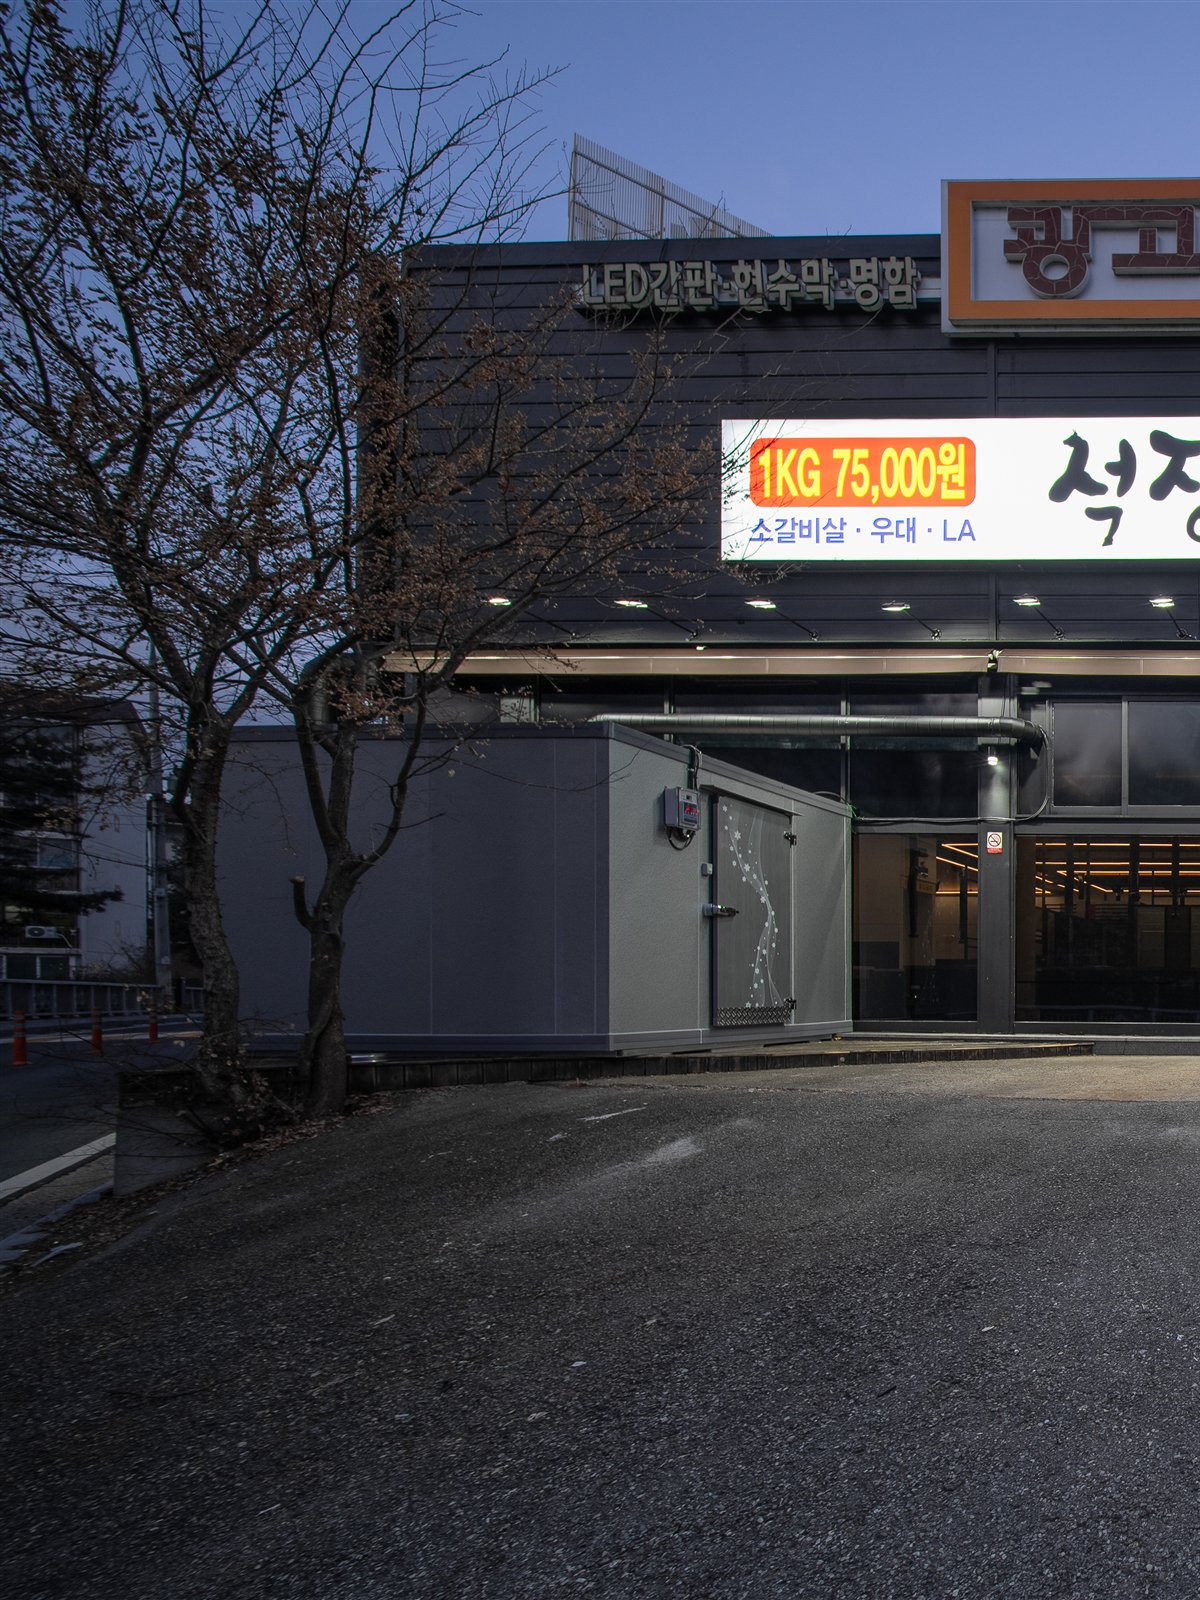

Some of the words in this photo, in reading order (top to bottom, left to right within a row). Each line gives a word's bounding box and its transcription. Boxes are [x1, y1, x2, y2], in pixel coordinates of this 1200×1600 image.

[757, 446, 822, 498] 1KG
[832, 442, 967, 505] 75,000원
[749, 516, 847, 545] 소갈비살
[870, 517, 917, 544] 우대
[942, 518, 976, 542] LA
